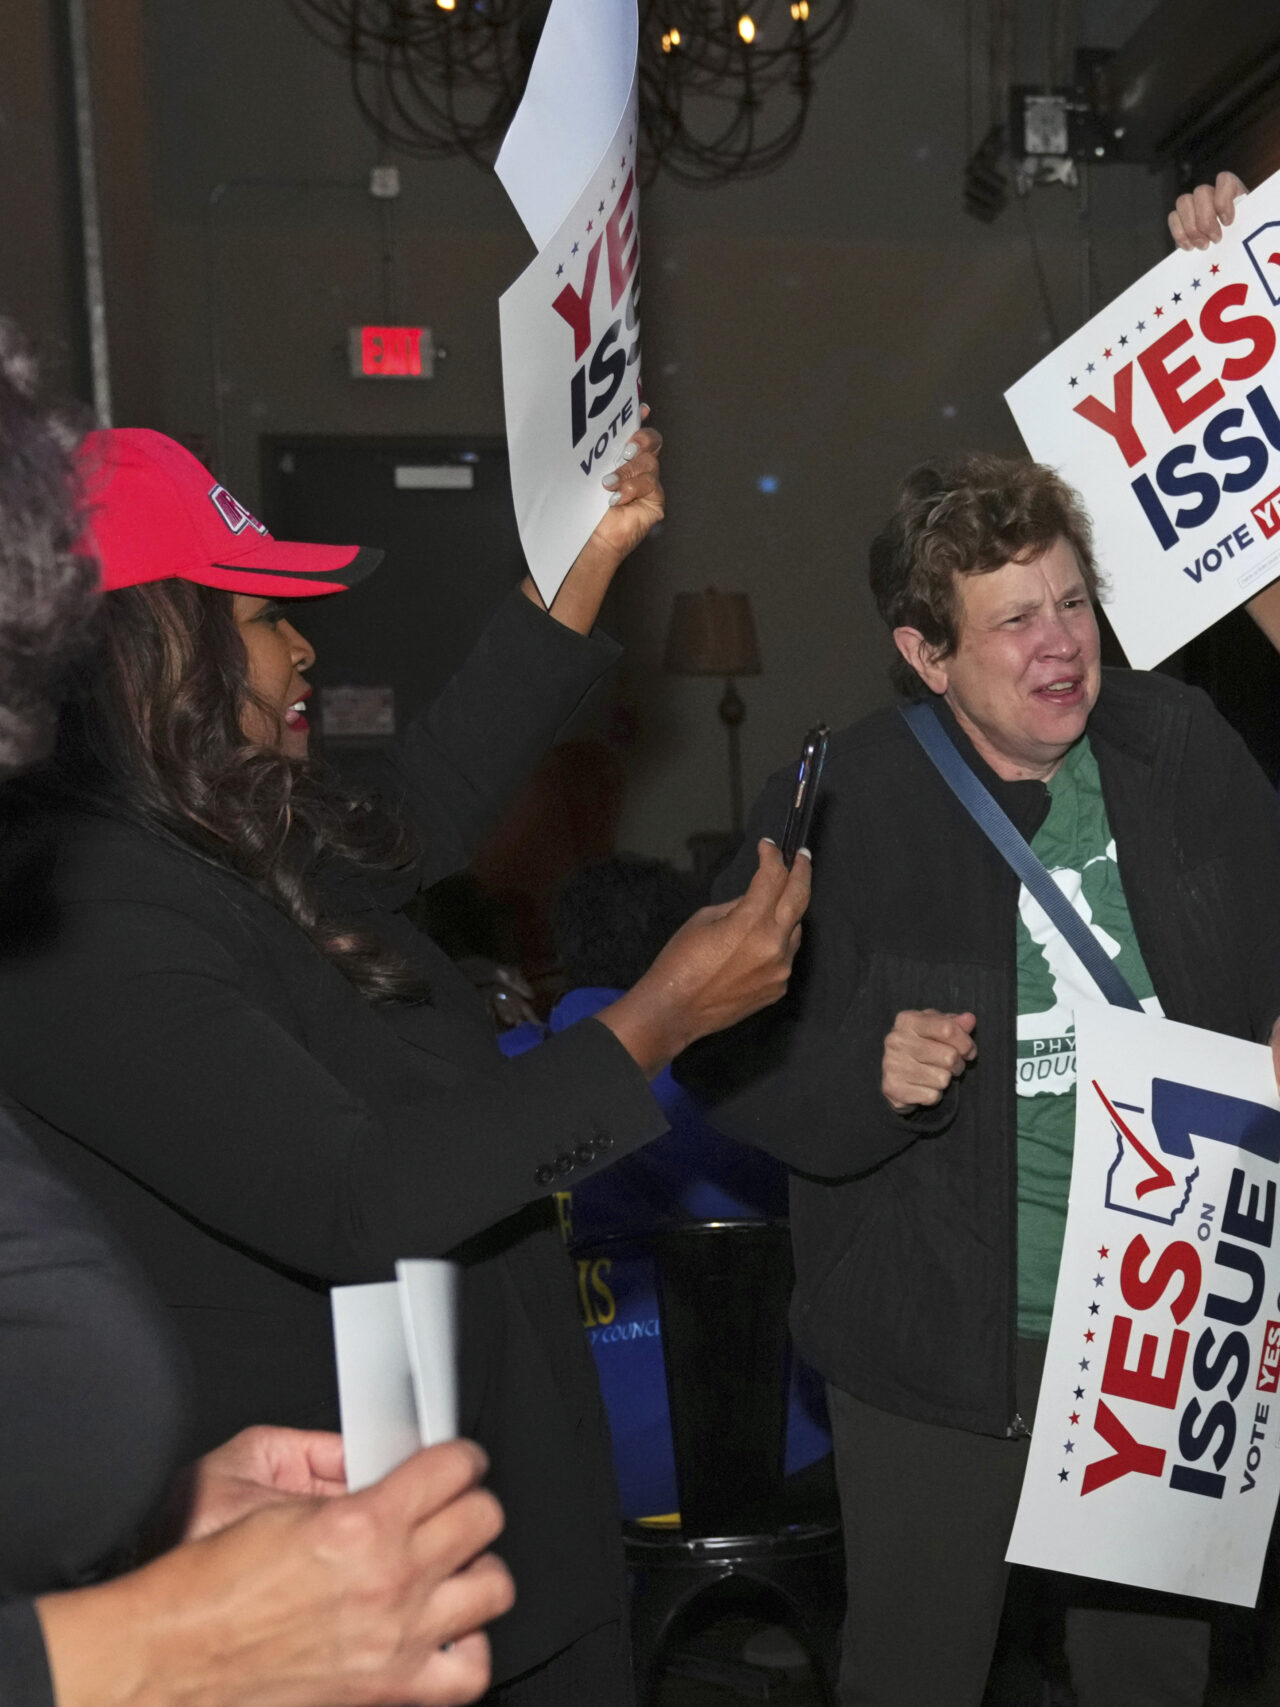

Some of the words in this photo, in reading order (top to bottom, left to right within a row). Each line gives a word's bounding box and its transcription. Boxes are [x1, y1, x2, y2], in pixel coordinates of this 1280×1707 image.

[552, 152, 640, 363] YE
[580, 396, 633, 476] VOTE
[1073, 283, 1276, 468] YES
[1183, 524, 1254, 583] VOTE
[1080, 1233, 1203, 1497] YES
[1197, 1203, 1217, 1242] ON
[1169, 1167, 1278, 1499] ISSUE
[1240, 1404, 1270, 1494] VOTE
